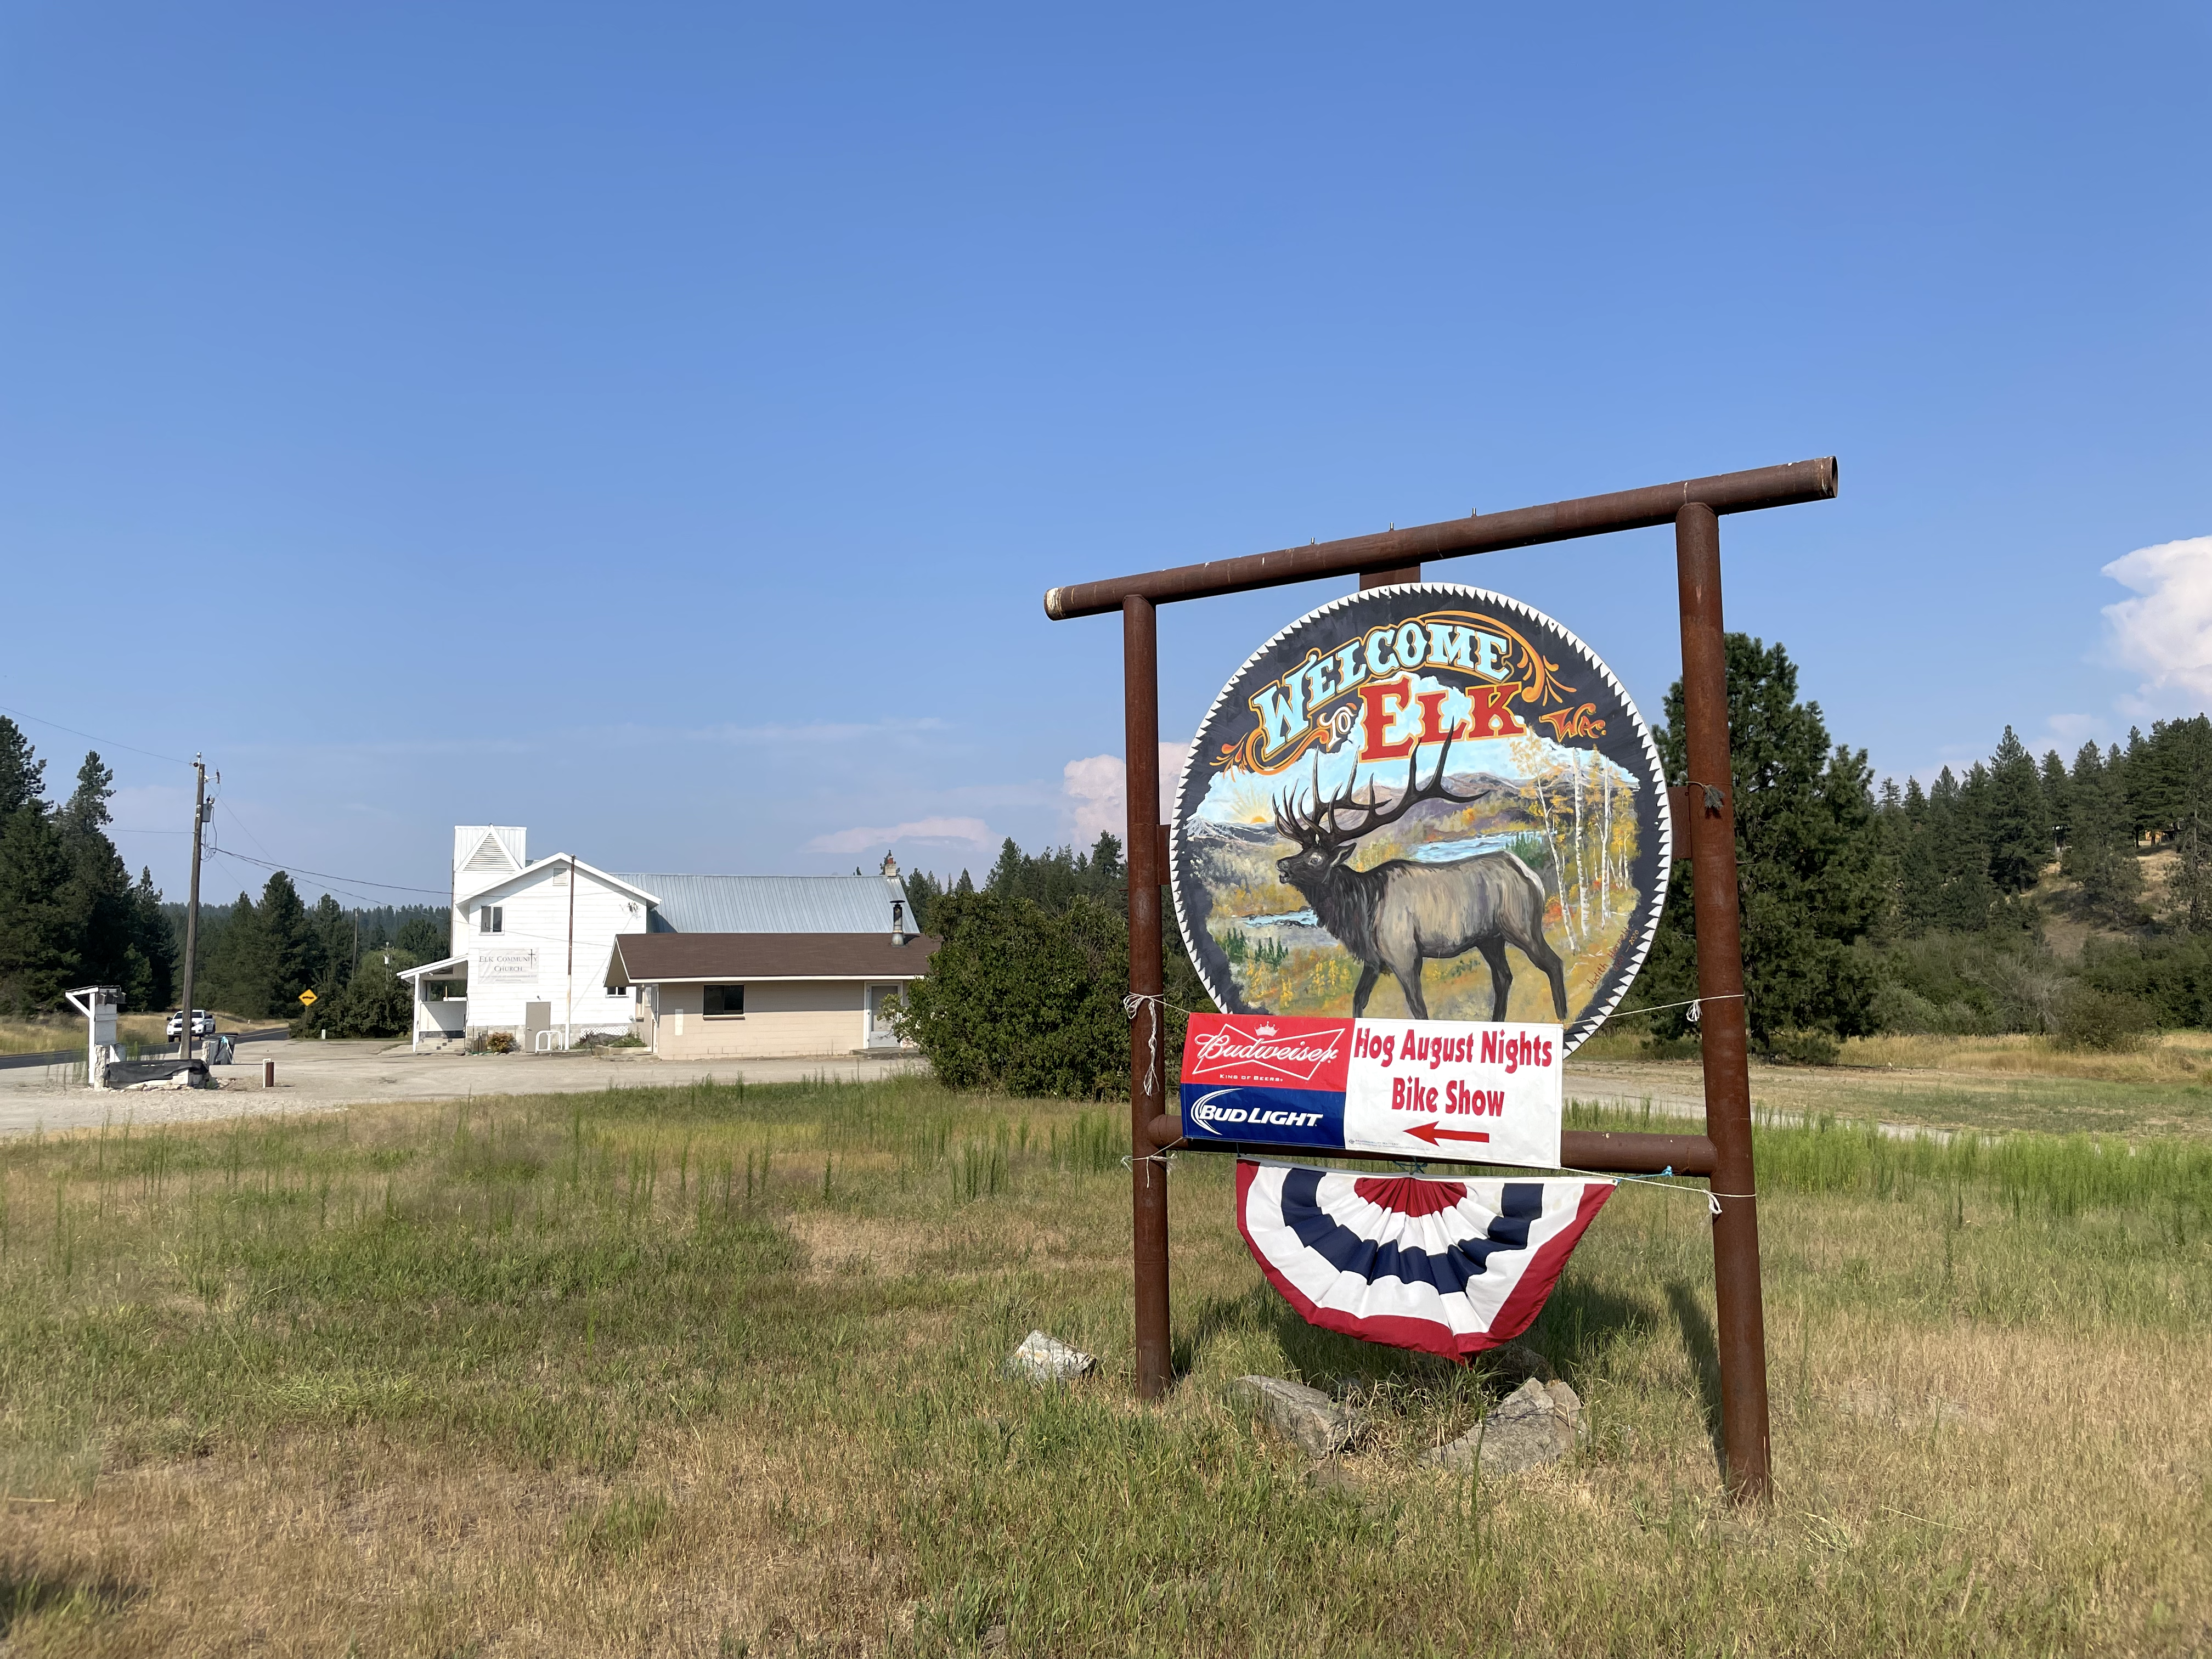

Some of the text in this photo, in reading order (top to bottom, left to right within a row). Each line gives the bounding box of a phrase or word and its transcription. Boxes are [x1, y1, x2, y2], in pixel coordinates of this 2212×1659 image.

[1251, 622, 1512, 756] WELCOME
[1318, 705, 1353, 751] TO
[1359, 675, 1527, 761] ELK
[1587, 963, 1609, 989] Judith
[1195, 1034, 1339, 1063] Budweiser
[1353, 1028, 1552, 1074] Hog August Nights
[1199, 1105, 1323, 1126] BUD LIGHT
[1391, 1075, 1505, 1117] Bike Show
